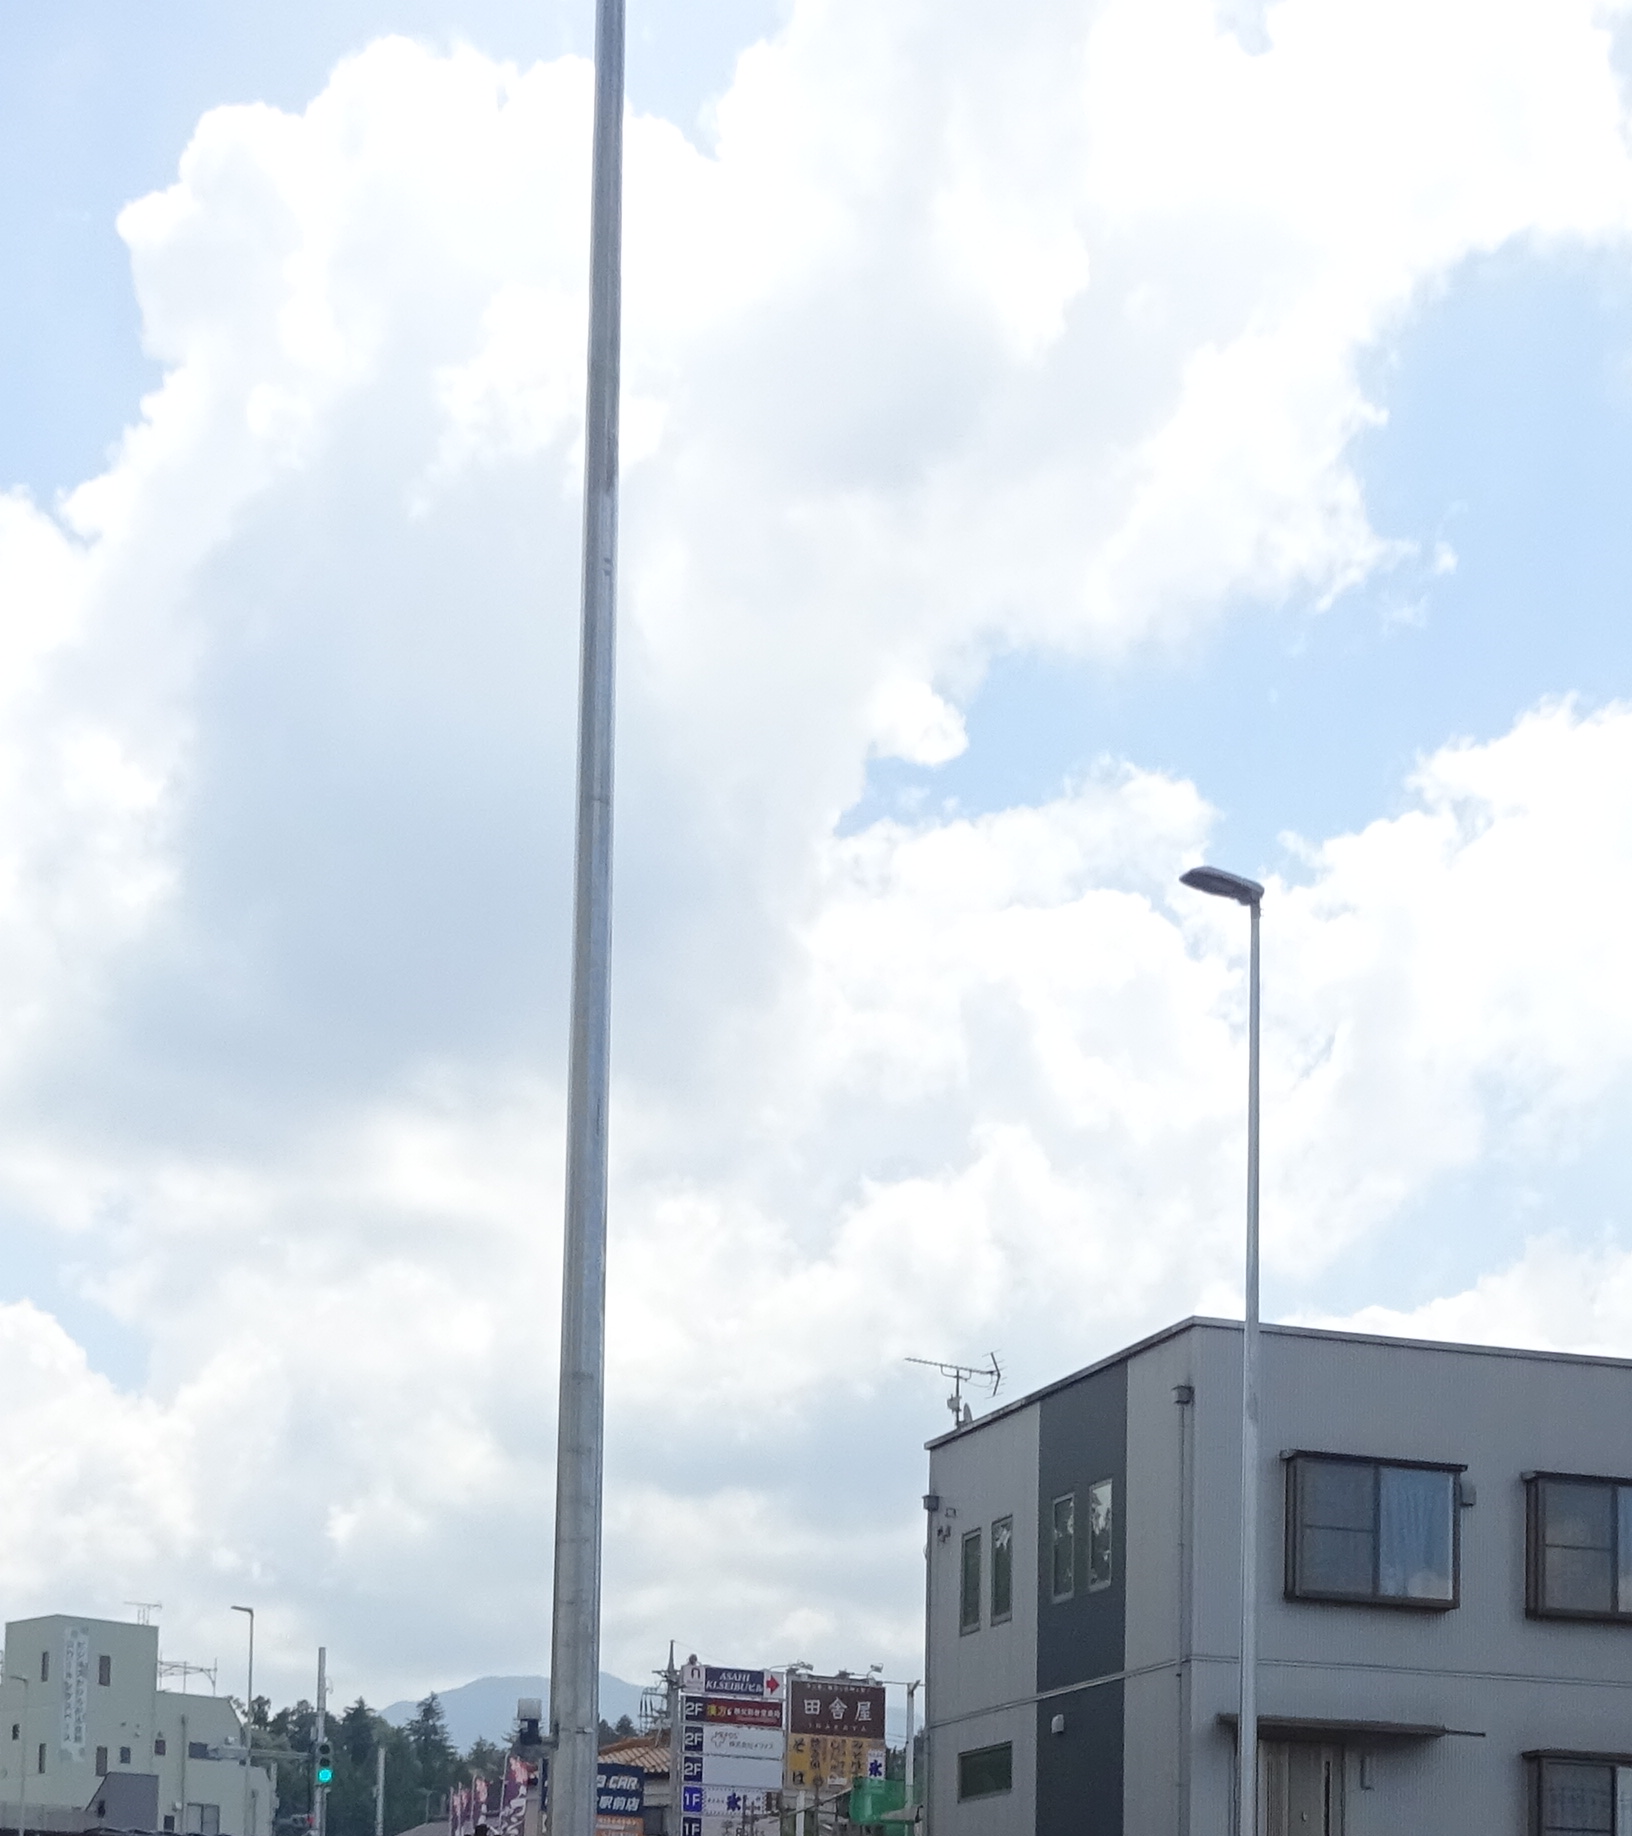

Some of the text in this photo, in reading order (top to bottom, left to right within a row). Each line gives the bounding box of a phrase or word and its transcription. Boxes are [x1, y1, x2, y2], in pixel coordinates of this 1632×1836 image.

[719, 1671, 751, 1682] ASAHI
[685, 1702, 703, 1716] 2F
[804, 1697, 872, 1721] 田舎屋
[685, 1733, 703, 1746] 2F
[684, 1763, 702, 1776] 2F
[869, 1759, 883, 1777] 氷
[608, 1776, 638, 1790] CAR
[597, 1796, 640, 1811] 駅前店
[684, 1792, 742, 1812] 1F 氷
[684, 1823, 700, 1836] 1F
